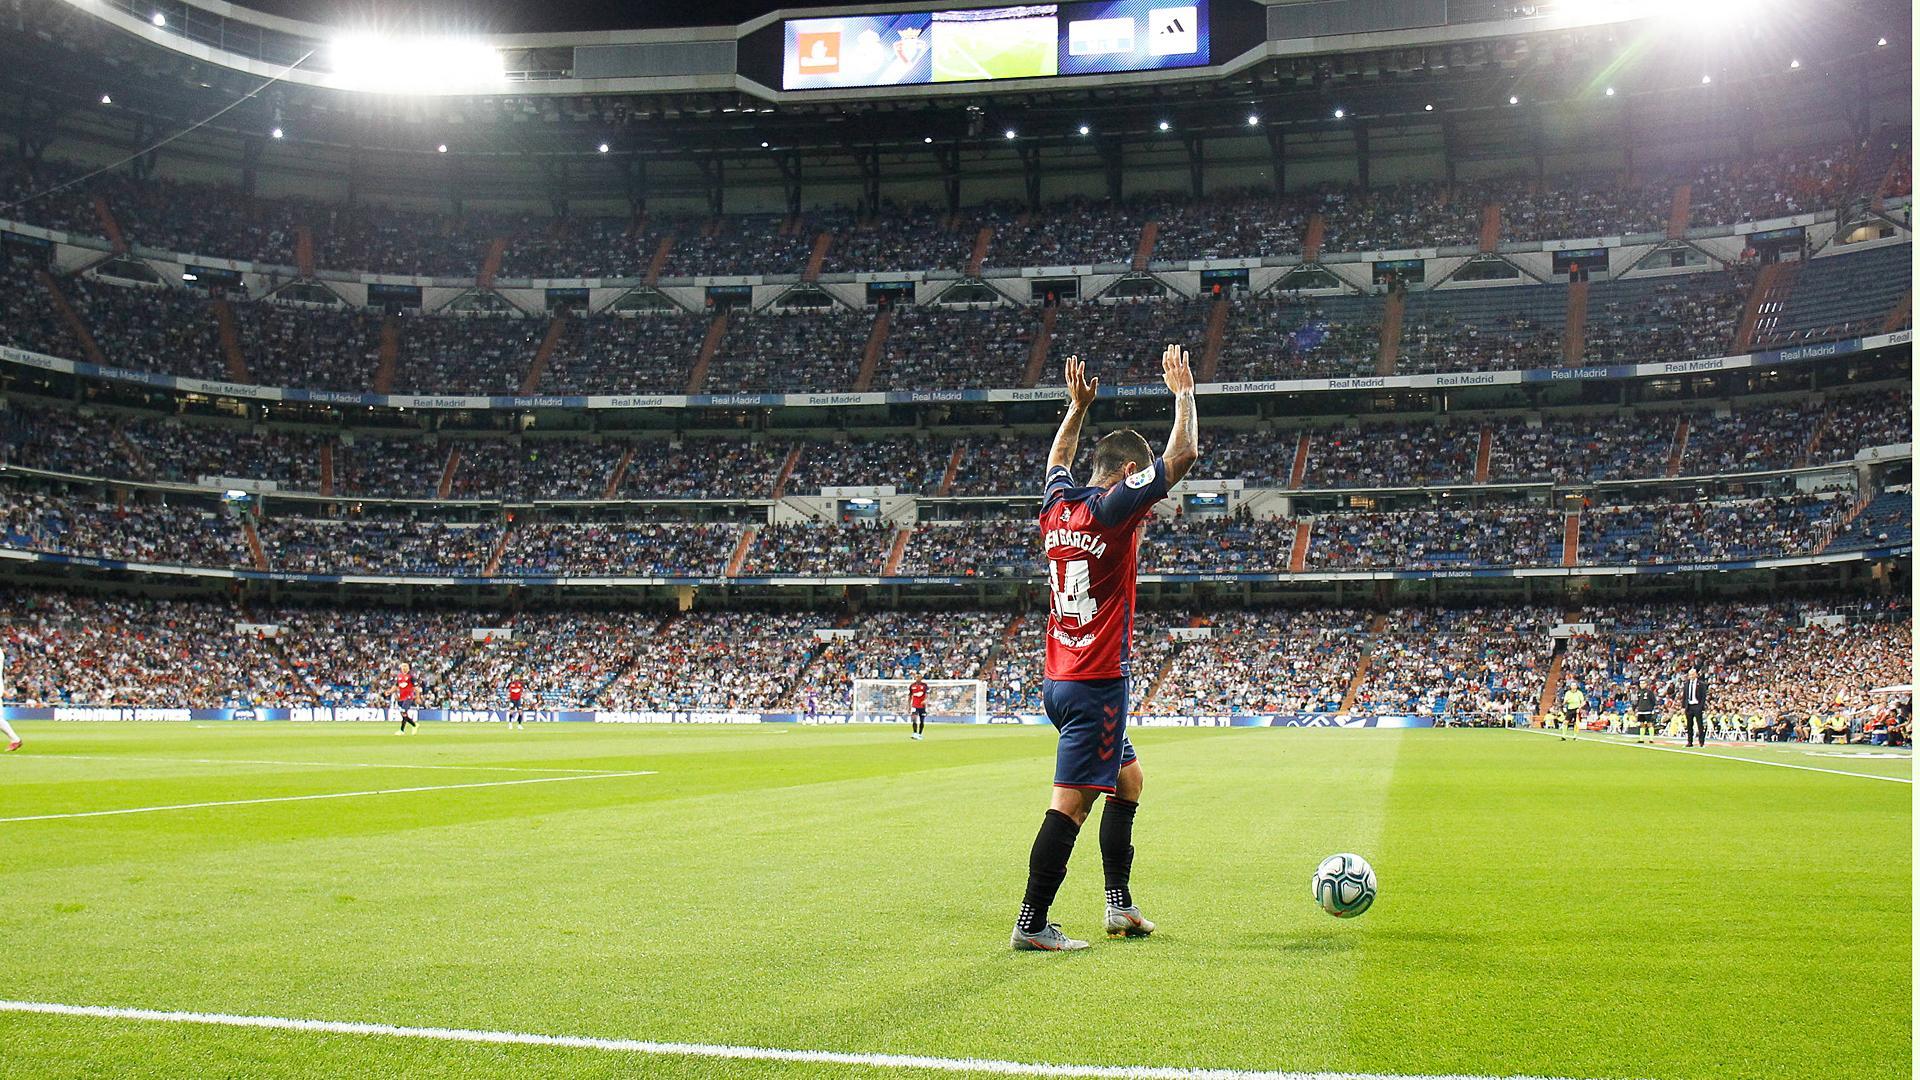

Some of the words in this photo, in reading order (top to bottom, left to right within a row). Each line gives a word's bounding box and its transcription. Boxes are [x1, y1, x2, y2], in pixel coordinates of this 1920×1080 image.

[1889, 333, 1909, 343] Real
[1780, 350, 1800, 360] Real
[1802, 344, 1835, 358] Madrid
[1665, 361, 1688, 372] Real
[1689, 359, 1723, 370] Madrid
[1551, 370, 1572, 379] Real
[1574, 368, 1607, 378] Madrid
[1329, 379, 1350, 389] Real
[1352, 377, 1384, 387] Madrid
[1436, 376, 1458, 385] Real
[1460, 375, 1494, 384] Madrid
[202, 383, 222, 394] Real
[225, 385, 257, 396] Madrid
[1117, 387, 1137, 396] Real
[1138, 386, 1168, 395] Madrid
[1222, 383, 1242, 392] Real
[1244, 382, 1275, 391] Madrid
[309, 391, 329, 401] Real
[331, 392, 361, 404] Madrid
[809, 396, 828, 405] Real
[831, 395, 861, 405] Madrid
[911, 392, 930, 402] Real
[932, 391, 962, 401] Madrid
[1012, 391, 1031, 400] Real
[1034, 390, 1066, 399] Madrid
[413, 400, 433, 408] Real
[435, 400, 466, 408] Madrid
[514, 398, 533, 407] Real
[535, 398, 562, 407] Madrid
[611, 398, 630, 407] Real
[633, 398, 662, 407] Madrid
[711, 396, 729, 405] Real
[731, 396, 760, 405] Madrid
[1059, 528, 1107, 559] GARCÍA
[1049, 559, 1098, 628] 14
[864, 715, 911, 723] MEN
